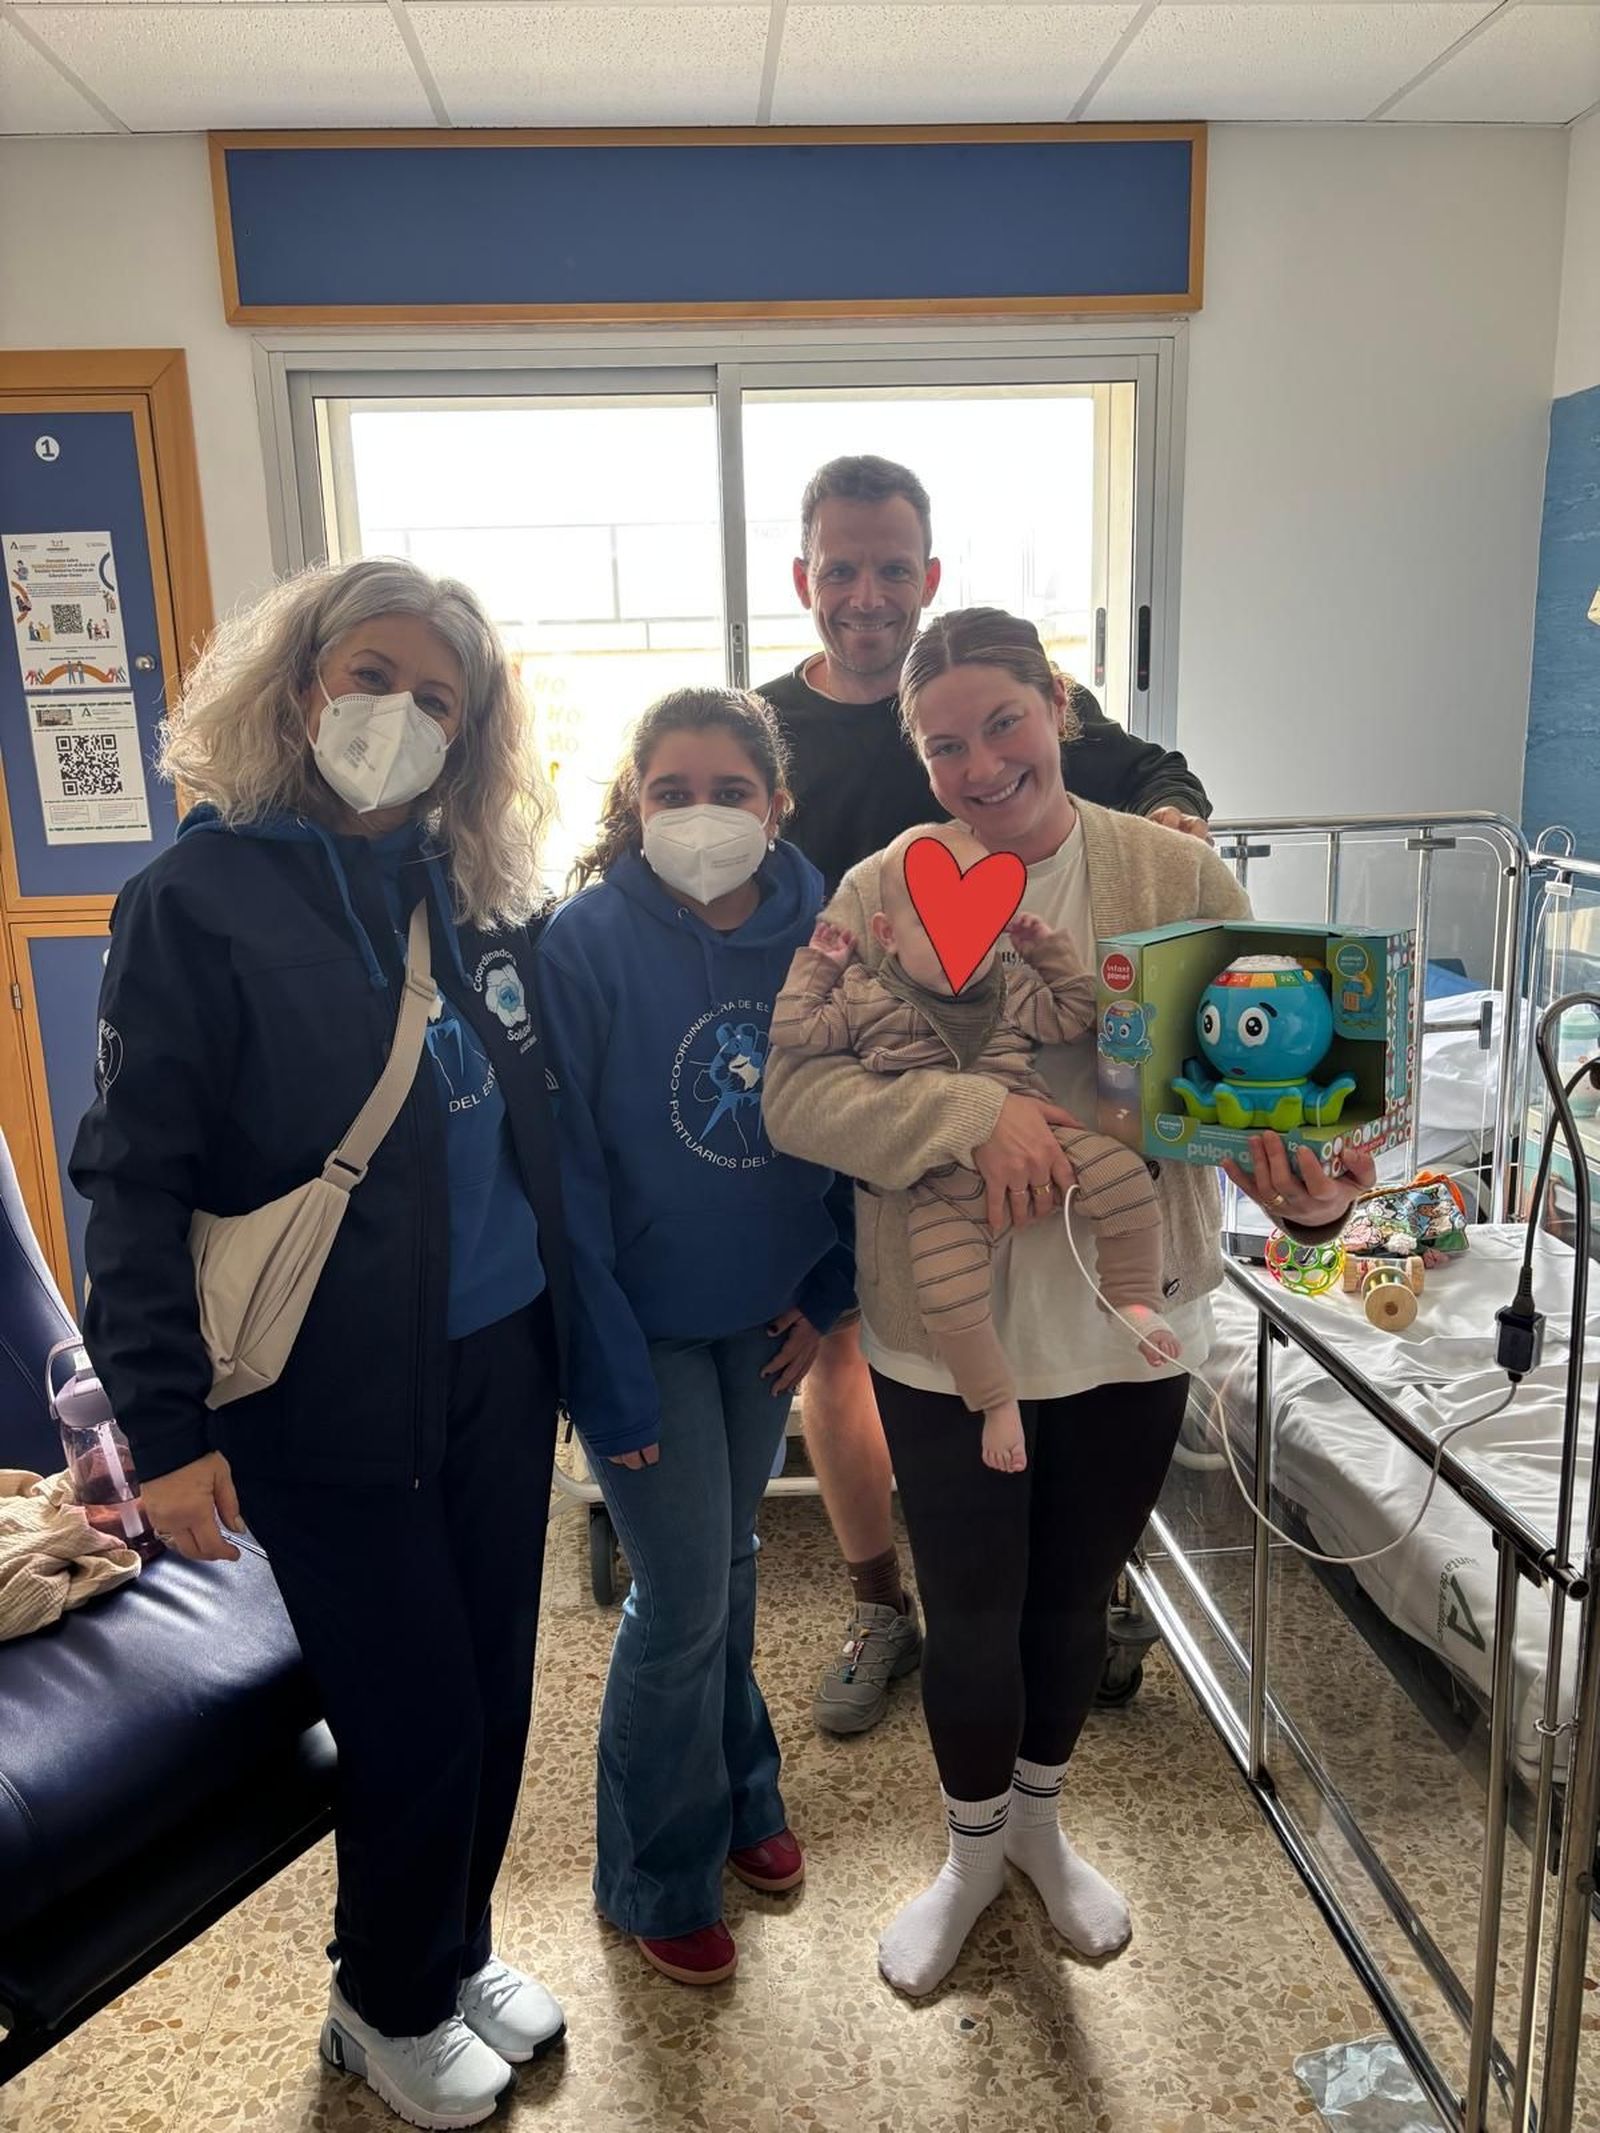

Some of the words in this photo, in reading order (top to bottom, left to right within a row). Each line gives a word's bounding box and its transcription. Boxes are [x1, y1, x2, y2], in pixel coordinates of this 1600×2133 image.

[41, 439, 55, 458] 1
[738, 999, 752, 1009] DE
[449, 1094, 481, 1113] DEL
[669, 1100, 737, 1169] PORTUARIOS
[741, 1156, 769, 1169] DEL
